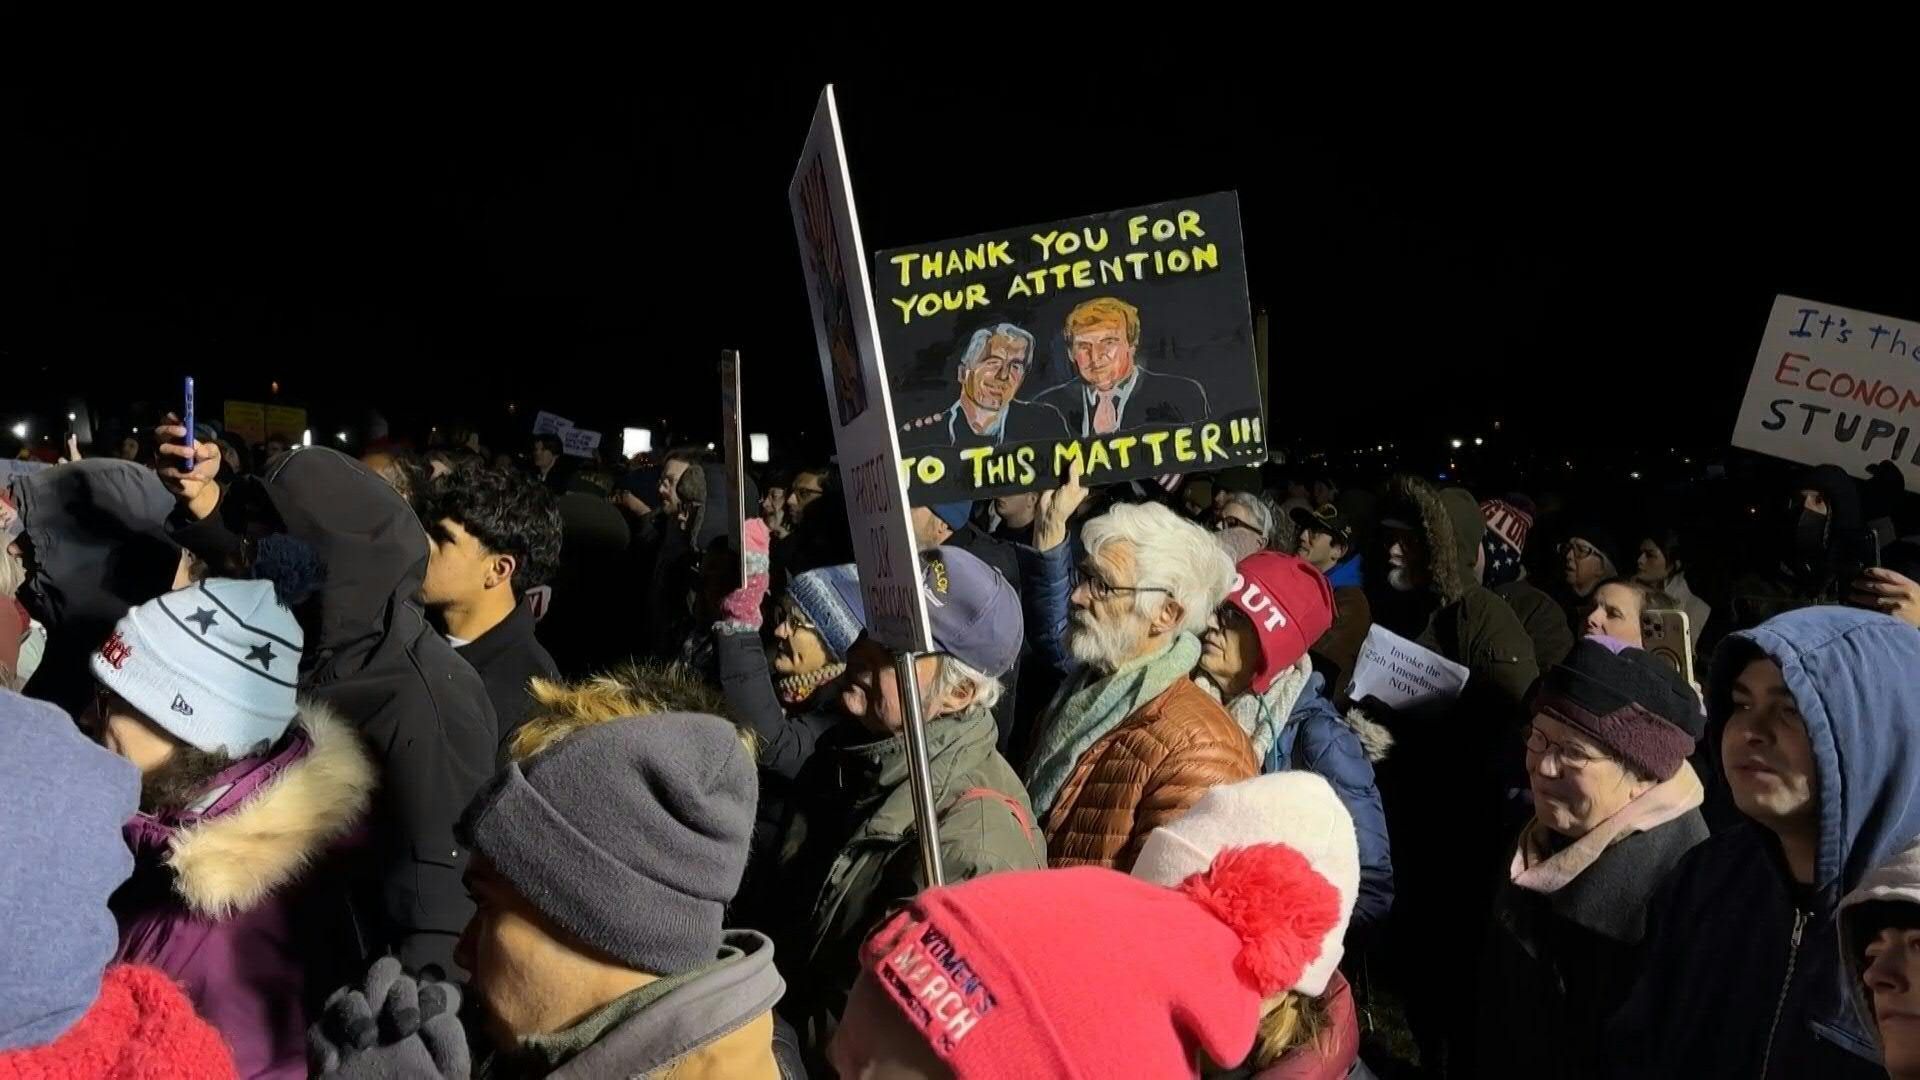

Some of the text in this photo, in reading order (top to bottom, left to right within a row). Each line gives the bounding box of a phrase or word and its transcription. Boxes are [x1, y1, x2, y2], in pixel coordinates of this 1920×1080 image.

[891, 209, 1205, 287] THANK YOU FOR
[892, 243, 1219, 324] YOUR ATTENTION
[1789, 308, 1853, 344] It's
[899, 455, 946, 489] TO
[960, 446, 1036, 488] THIS
[1365, 648, 1386, 667] 25th
[1390, 645, 1441, 679] Invoke the
[1389, 676, 1419, 697] NOW
[894, 943, 981, 1041] MARCH
